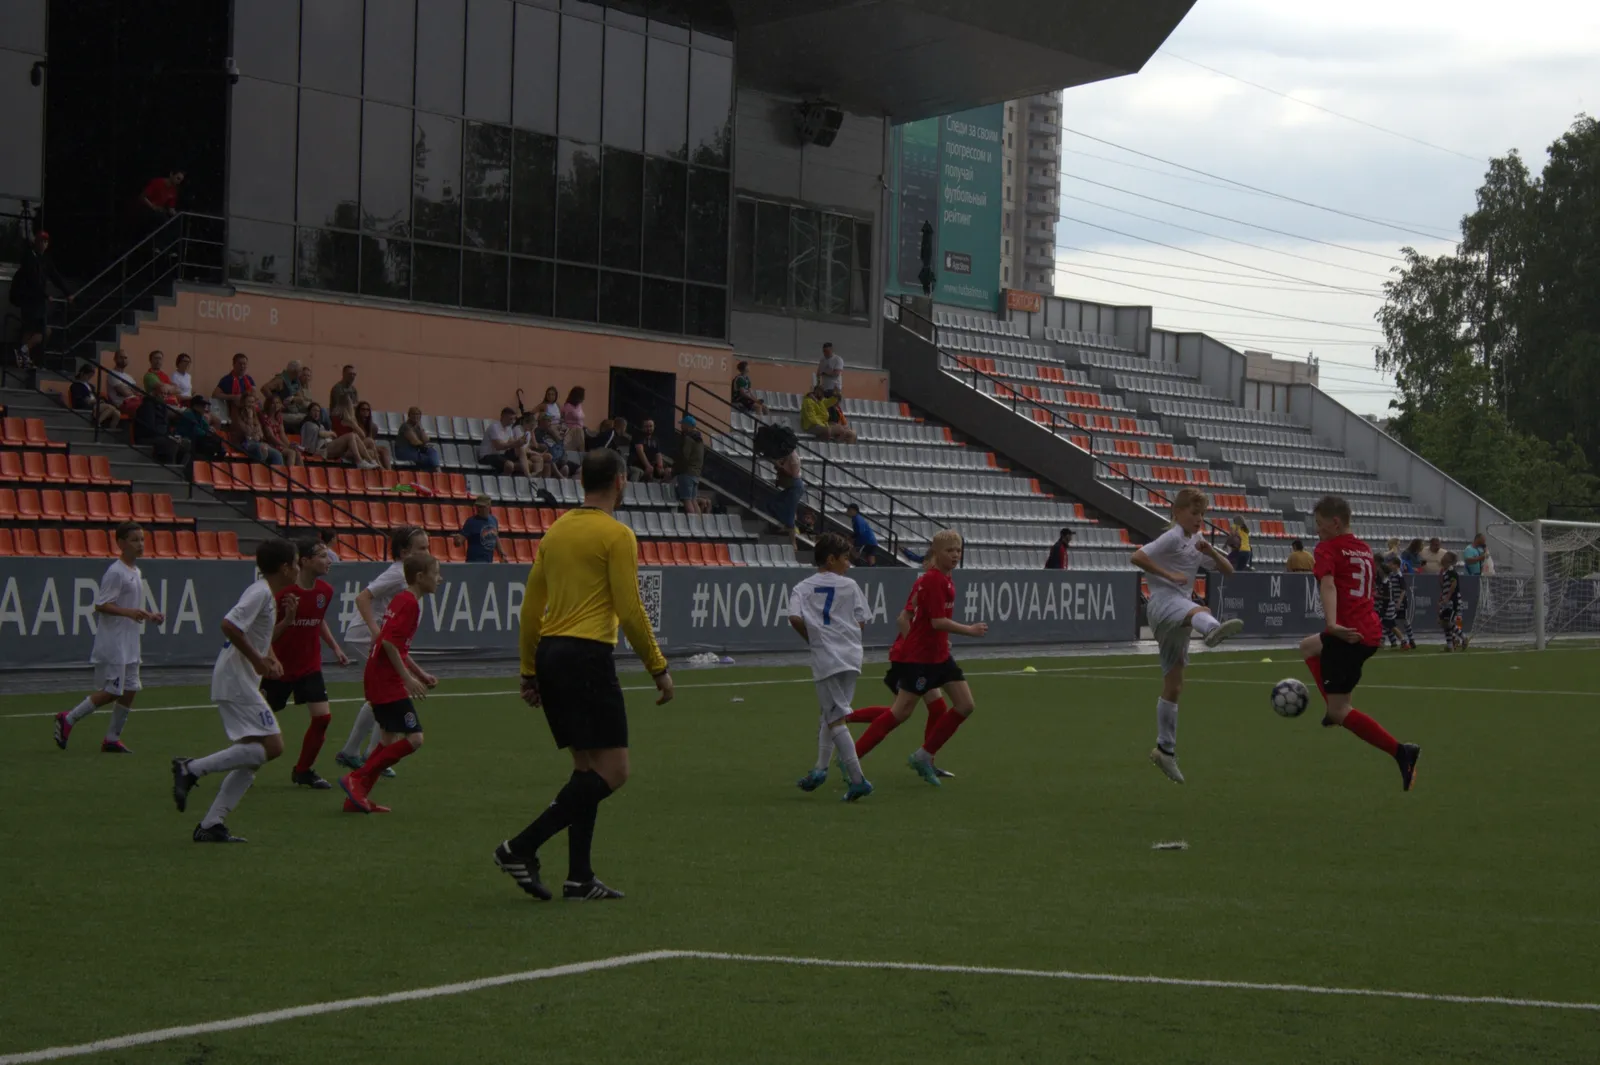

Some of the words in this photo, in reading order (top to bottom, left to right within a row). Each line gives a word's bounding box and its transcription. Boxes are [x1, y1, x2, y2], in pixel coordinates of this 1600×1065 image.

[946, 115, 968, 136] Следи
[968, 124, 976, 137] за
[977, 127, 998, 142] своим
[945, 141, 986, 162] прогрессом
[944, 164, 974, 183] получай
[944, 182, 987, 206] футбольный
[943, 208, 972, 226] рейтинг
[198, 299, 251, 322] СЕКТОР
[678, 352, 715, 370] СЕКТОР
[1349, 557, 1373, 600] 31
[0, 576, 204, 636] AARNA
[814, 586, 836, 625] 7
[964, 581, 1117, 622] #NOVAARENA
[1258, 602, 1273, 614] NOVA
[1274, 602, 1291, 613] ARENA
[258, 710, 274, 726] 16
